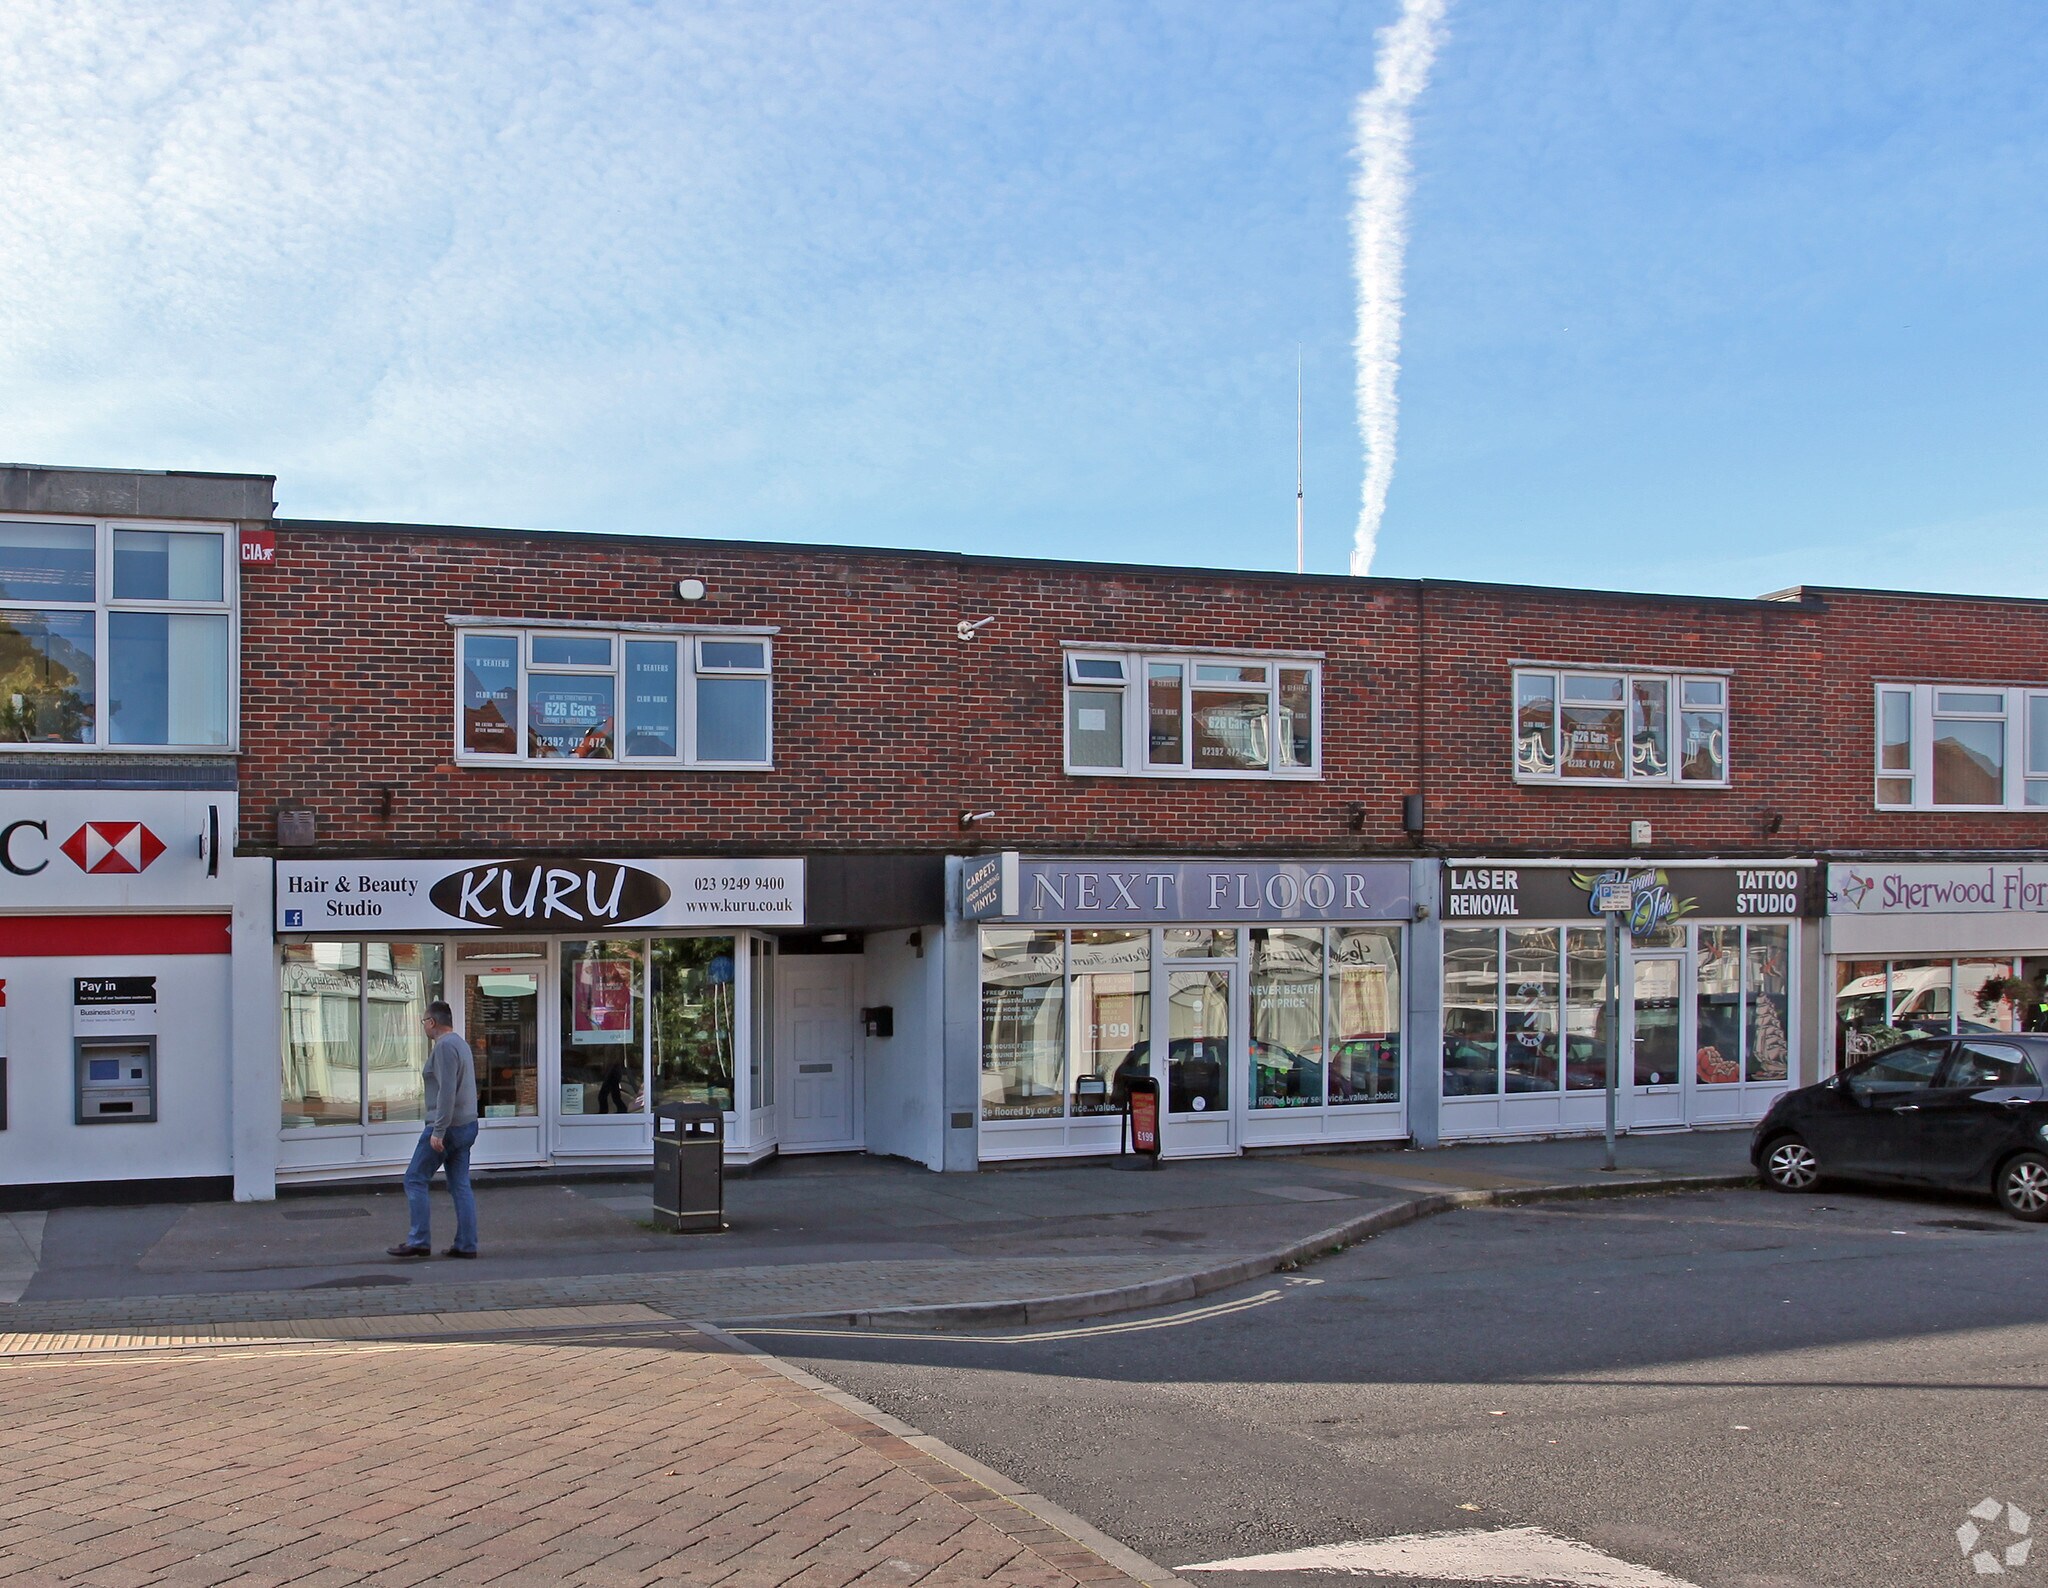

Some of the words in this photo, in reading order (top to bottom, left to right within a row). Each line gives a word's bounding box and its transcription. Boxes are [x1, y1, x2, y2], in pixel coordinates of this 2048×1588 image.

[242, 543, 262, 561] CIA
[544, 702, 567, 716] 626
[570, 702, 597, 717] Cars
[1208, 716, 1227, 729] 626
[1228, 717, 1250, 729] Cars
[536, 736, 564, 747] 02392
[568, 737, 584, 748] 472
[588, 737, 606, 748] 472
[1573, 731, 1589, 742] 626
[1590, 732, 1609, 743] Cars
[1202, 746, 1224, 756] 02392
[1589, 760, 1600, 768] 472
[1603, 761, 1615, 769] 472
[0, 819, 49, 877] C
[966, 859, 996, 890] CARPETS
[1450, 869, 1519, 891] LASER
[1736, 870, 1798, 890] TATTOO
[288, 875, 330, 893] Hair
[334, 877, 352, 893] &
[358, 876, 419, 896] Beauty
[694, 878, 717, 891] 023
[721, 877, 751, 891] 9249
[755, 876, 785, 891] 9400
[1882, 867, 1995, 910] Sherwood
[458, 865, 627, 923] KURU
[1032, 873, 1176, 911] NEXT
[1207, 873, 1371, 910] FLOOR
[326, 898, 383, 917] Studio
[686, 896, 794, 915] www.kuru.co.uk
[972, 888, 997, 913] VINYLS
[1450, 894, 1519, 916] REMOVAL
[1736, 893, 1797, 914] STUDIO
[80, 981, 102, 993] Pay
[105, 980, 116, 991] in
[1250, 985, 1281, 995] NEVER
[1284, 984, 1319, 995] BEATEN
[1261, 999, 1275, 1008] ON
[1088, 1023, 1129, 1038] £199
[1259, 1096, 1284, 1105] floored
[1286, 1096, 1295, 1106] by
[995, 1106, 1023, 1116] floored
[1026, 1107, 1036, 1117] by
[1037, 1107, 1050, 1115] our
[1138, 1131, 1153, 1141] £199
